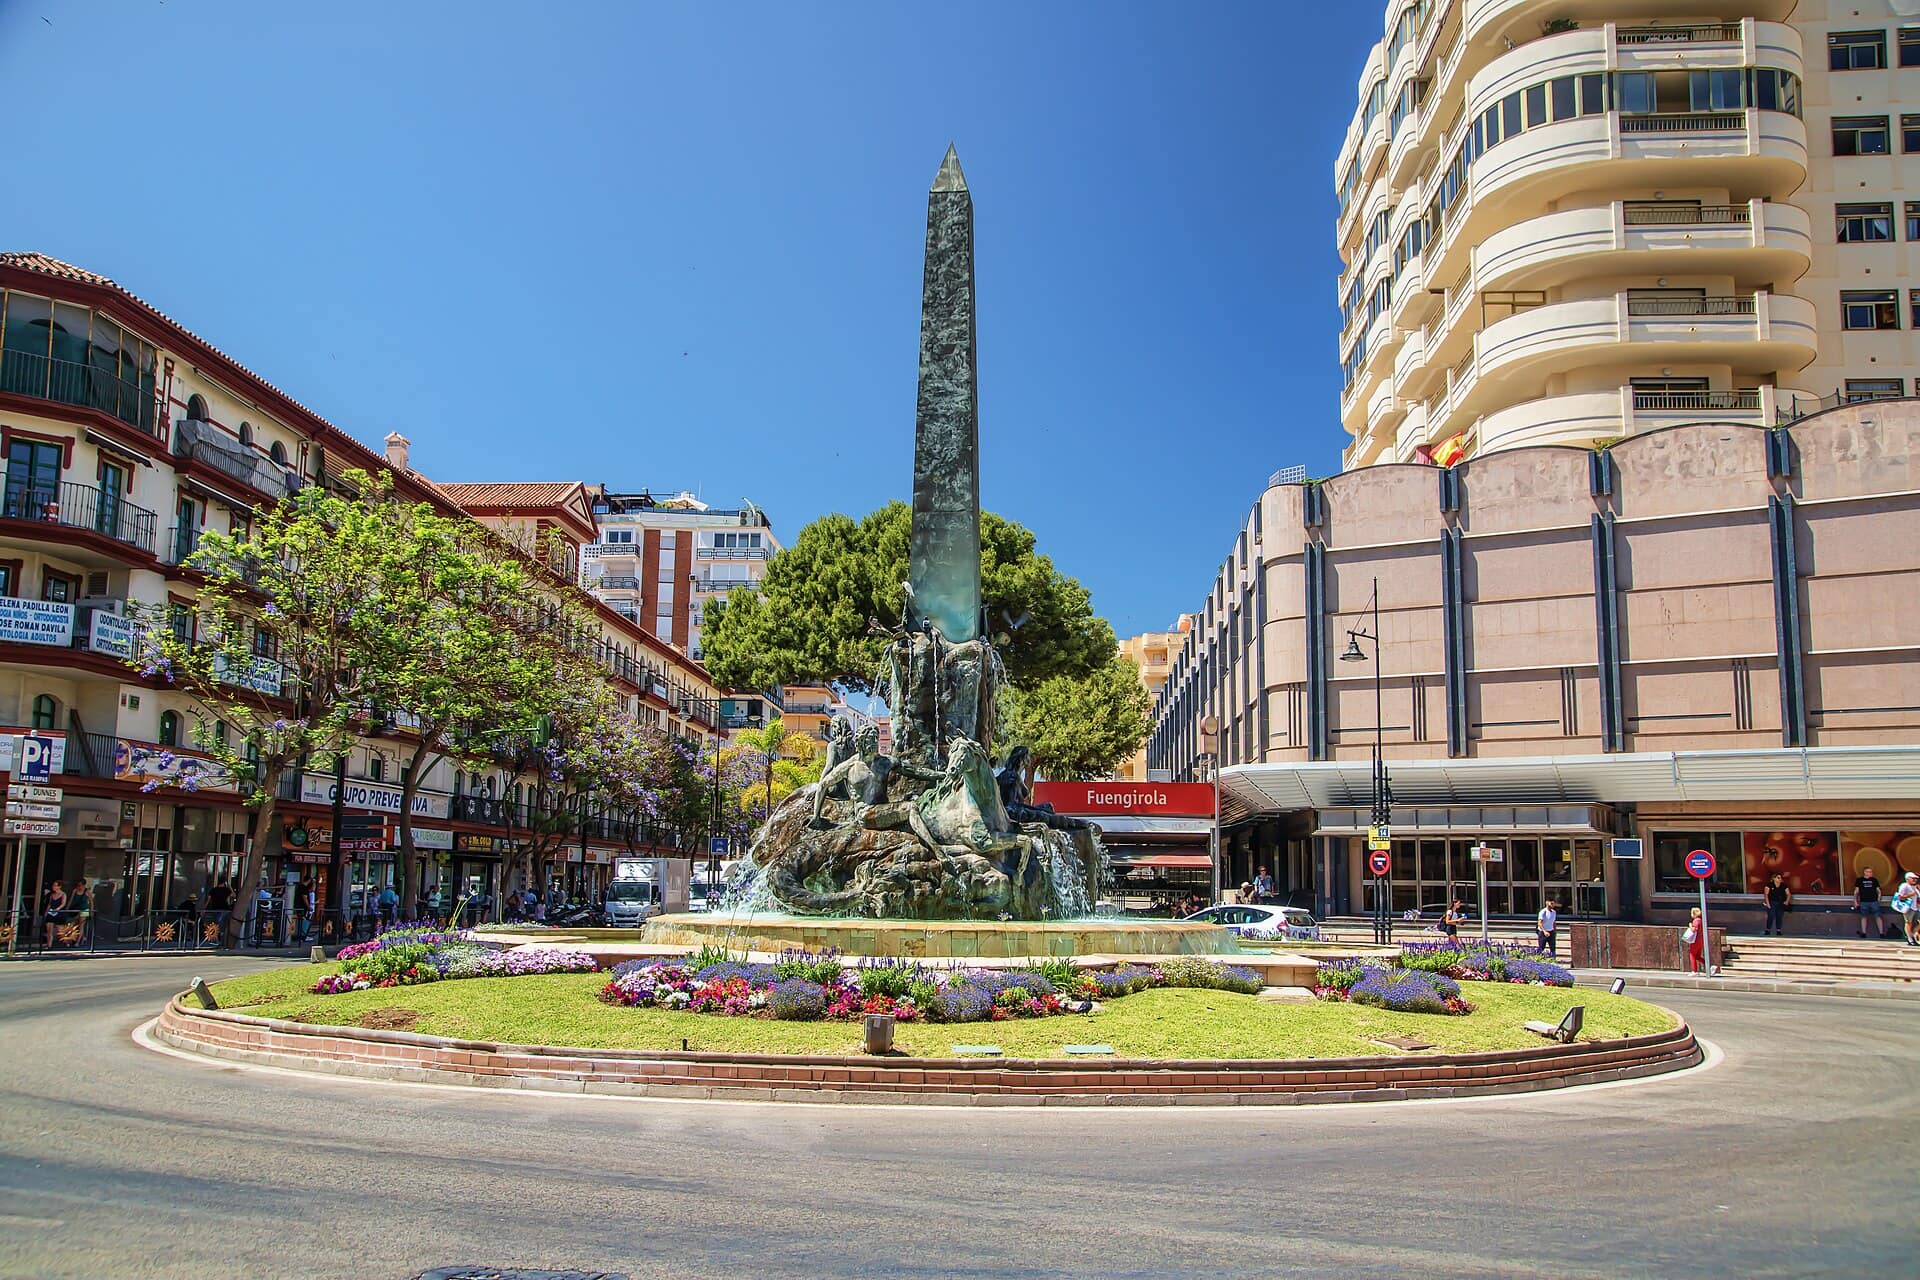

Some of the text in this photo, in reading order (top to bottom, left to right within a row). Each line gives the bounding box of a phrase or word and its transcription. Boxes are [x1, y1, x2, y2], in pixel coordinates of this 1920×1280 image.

[22, 601, 50, 612] PADILLA
[51, 604, 69, 614] LEON
[14, 620, 40, 631] ROMAN
[41, 623, 66, 634] DAVILA
[31, 632, 57, 643] ADULTOS
[20, 738, 42, 774] P
[33, 788, 57, 797] DUNNES
[328, 784, 428, 813] GUPO PREVEIVA
[1087, 789, 1167, 808] Fuengirola
[360, 841, 380, 849] KFC
